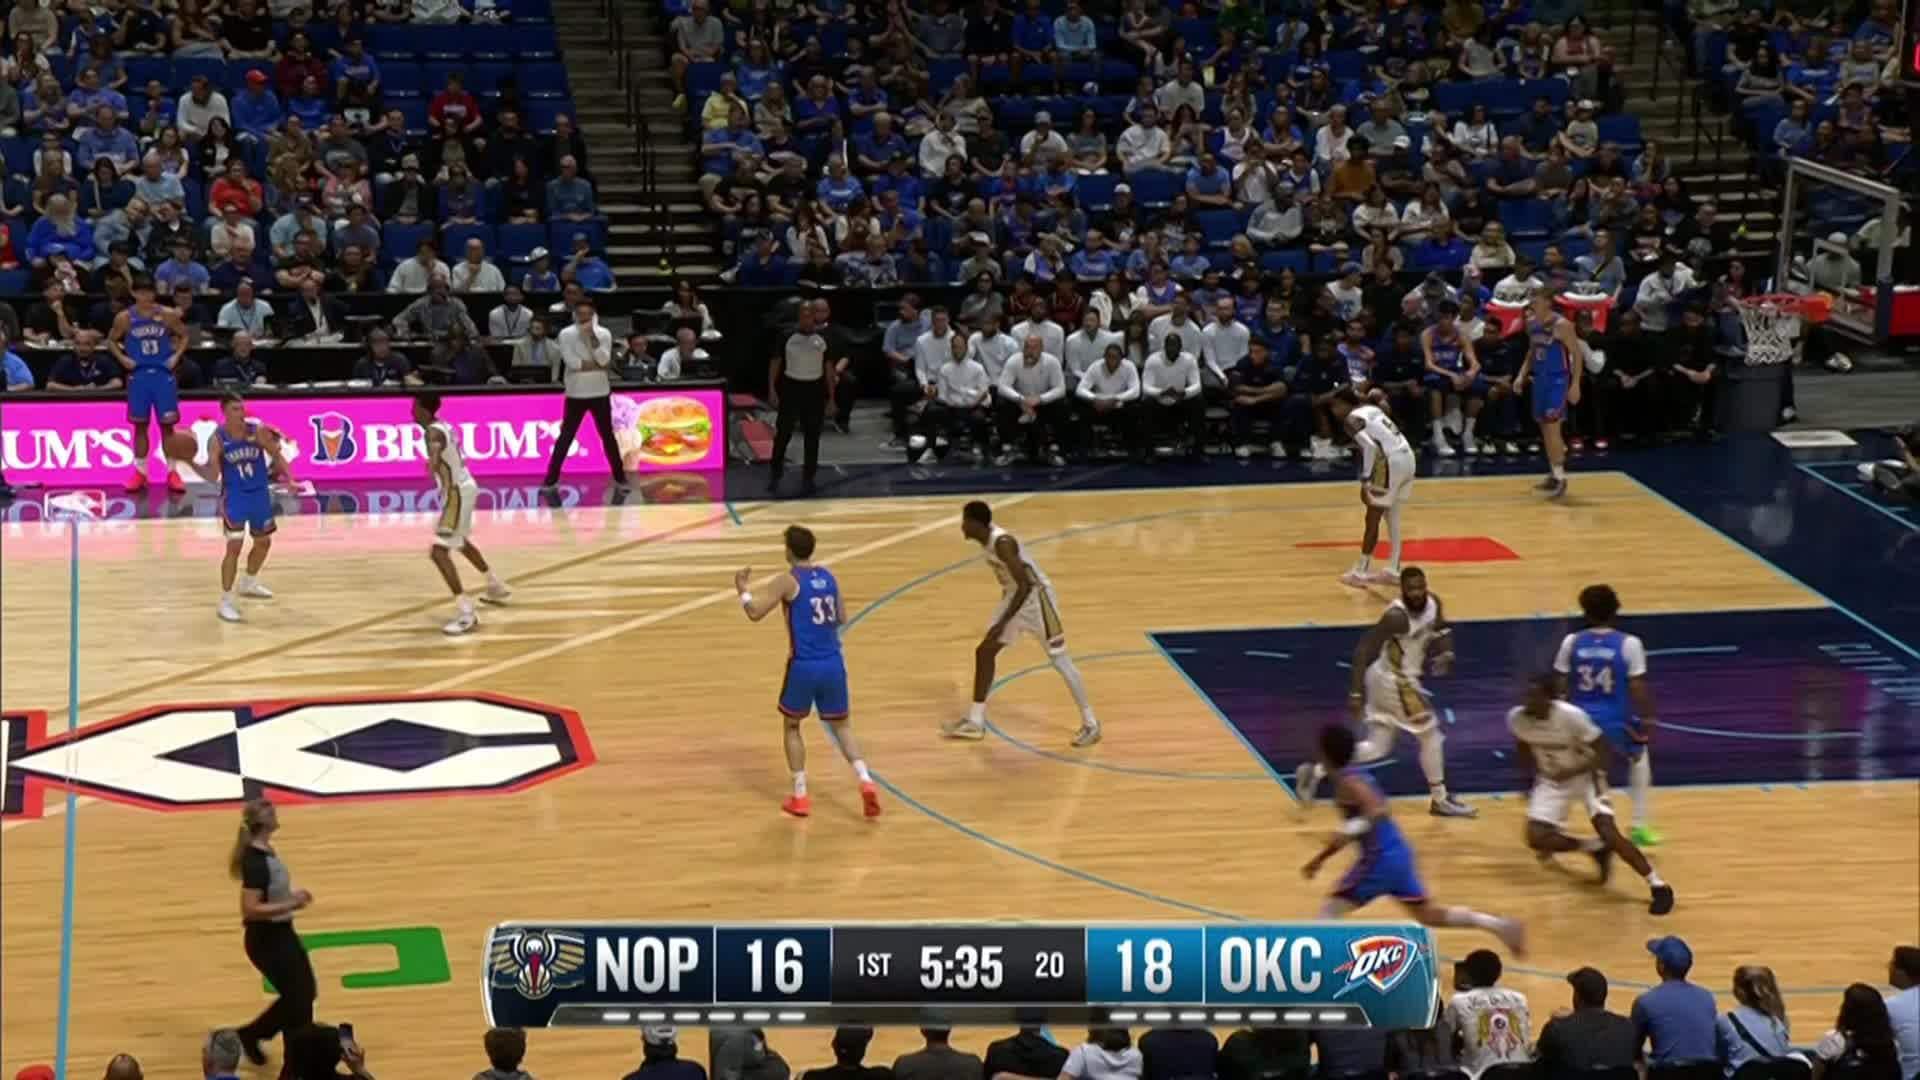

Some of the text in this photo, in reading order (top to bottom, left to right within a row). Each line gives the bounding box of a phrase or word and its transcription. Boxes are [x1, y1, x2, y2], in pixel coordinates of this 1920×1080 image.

[1, 428, 135, 470] UM'S
[237, 461, 254, 478] 14
[809, 595, 837, 625] 33
[1577, 663, 1613, 694] 34
[0, 696, 590, 808] KC
